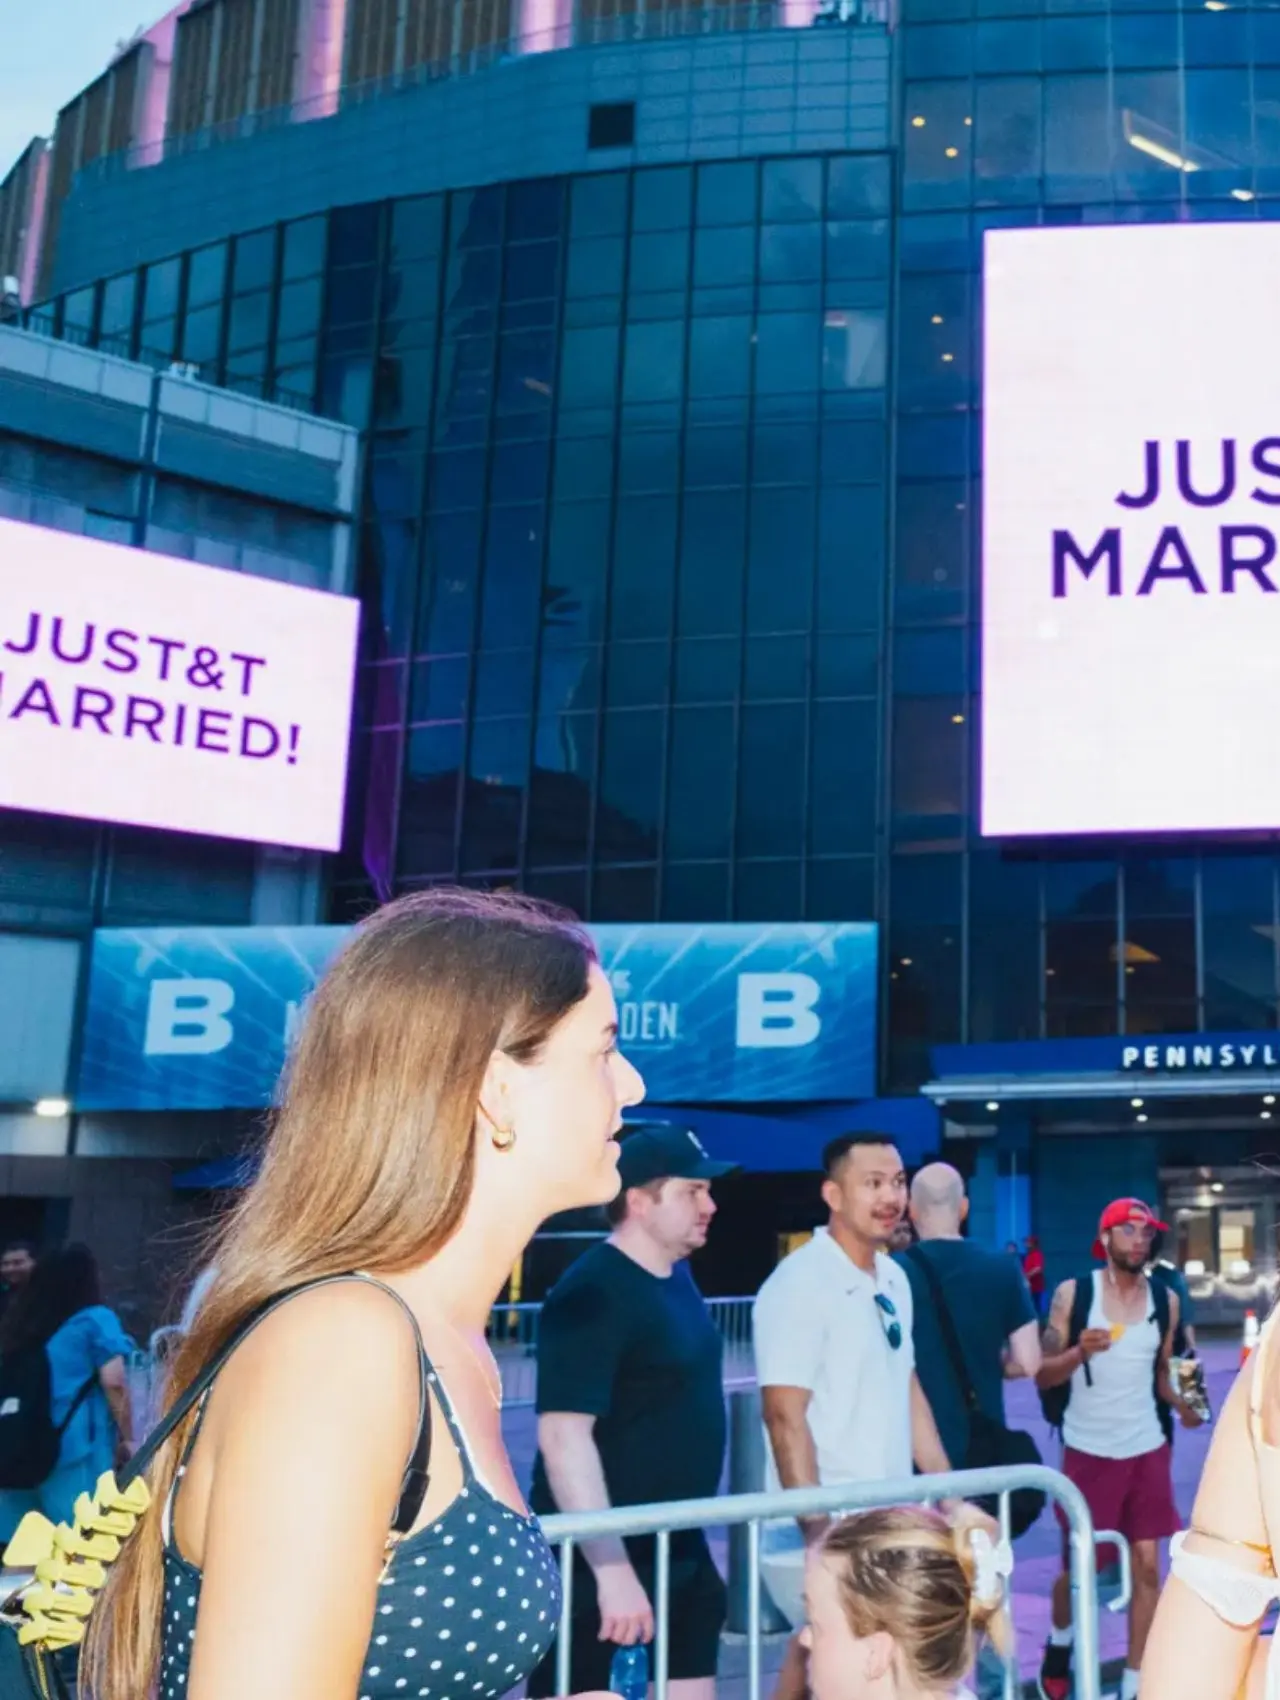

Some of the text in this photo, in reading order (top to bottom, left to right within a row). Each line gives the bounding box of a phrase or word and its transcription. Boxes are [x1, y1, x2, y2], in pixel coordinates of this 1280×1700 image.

[3, 612, 266, 696] JUST&T
[0, 671, 301, 764] ARRIED!
[144, 978, 234, 1055] B
[620, 1002, 678, 1040] DEN
[736, 972, 821, 1048] B
